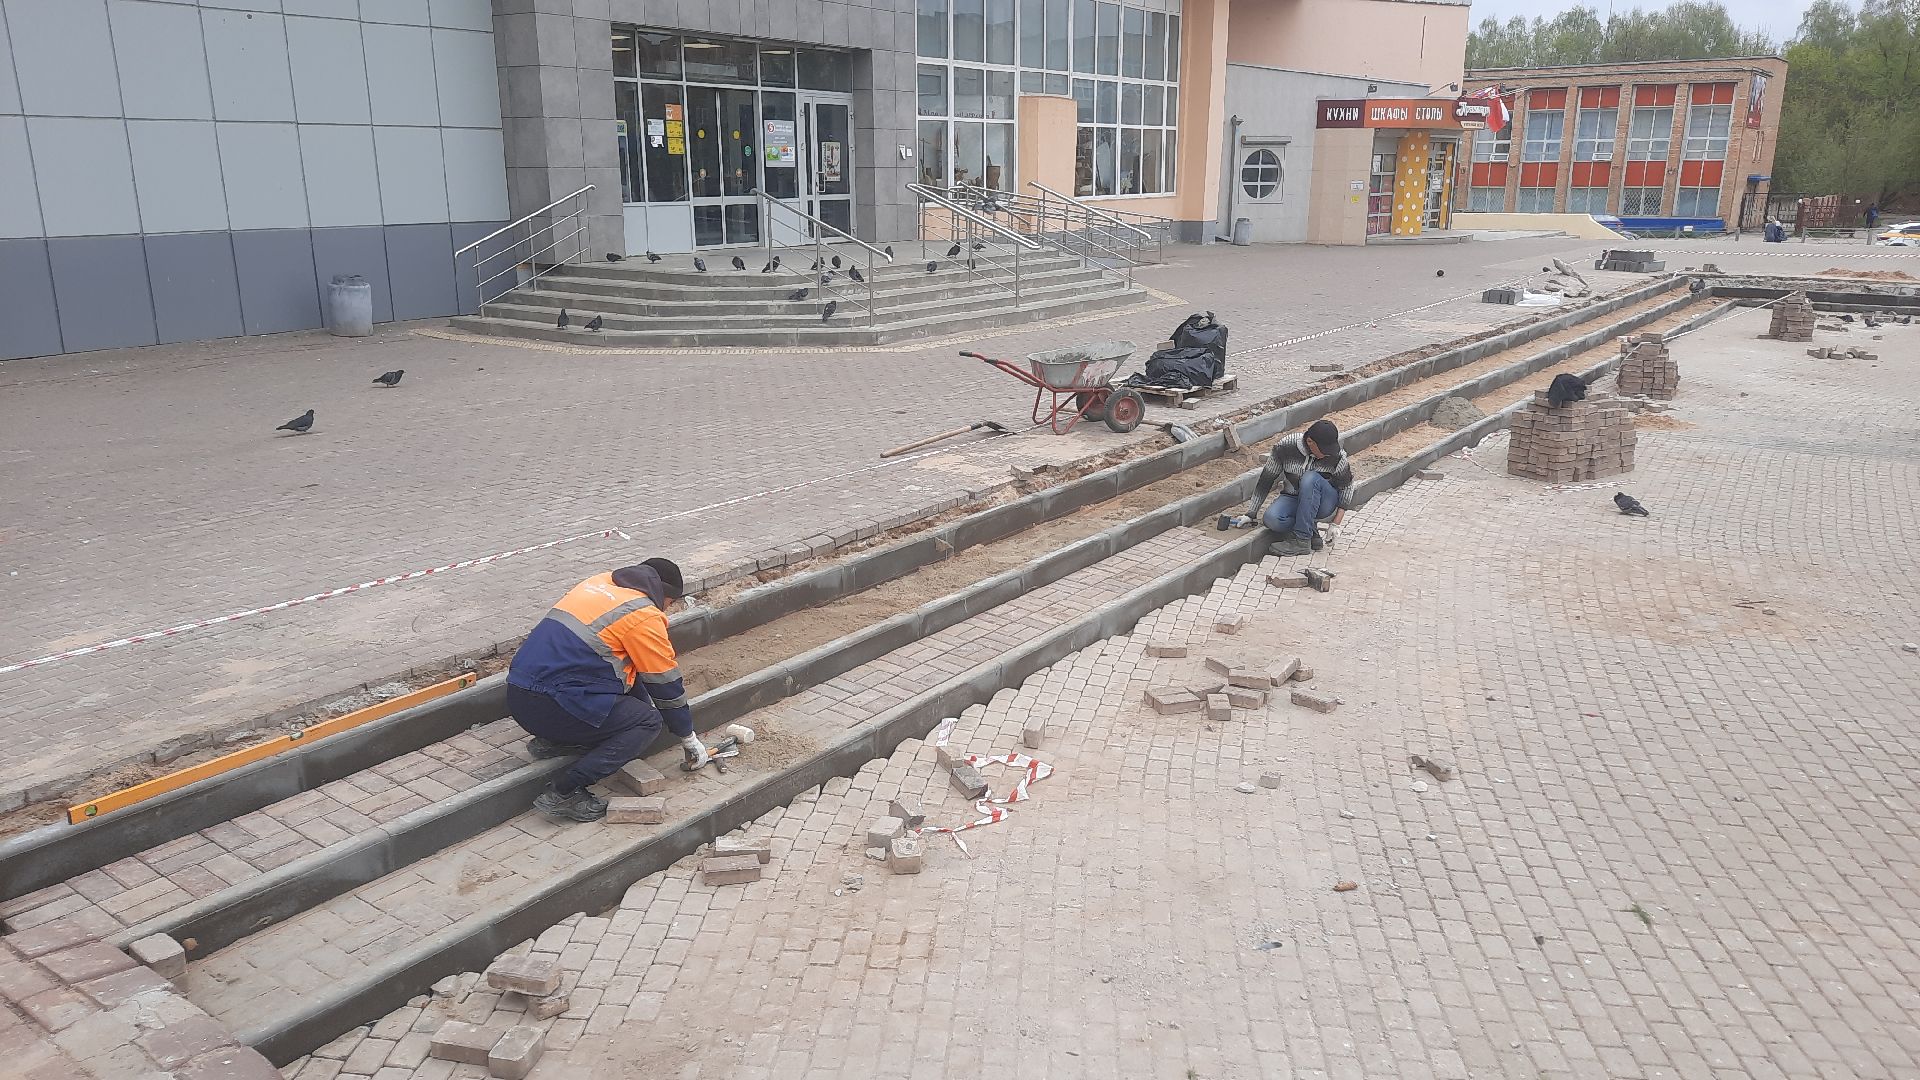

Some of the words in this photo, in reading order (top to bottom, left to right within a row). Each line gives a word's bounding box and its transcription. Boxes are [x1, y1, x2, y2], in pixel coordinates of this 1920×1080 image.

[1326, 107, 1359, 121] КУХНИ
[1371, 107, 1408, 121] ШКАФЫ
[1415, 107, 1443, 121] СТОЛЫ
